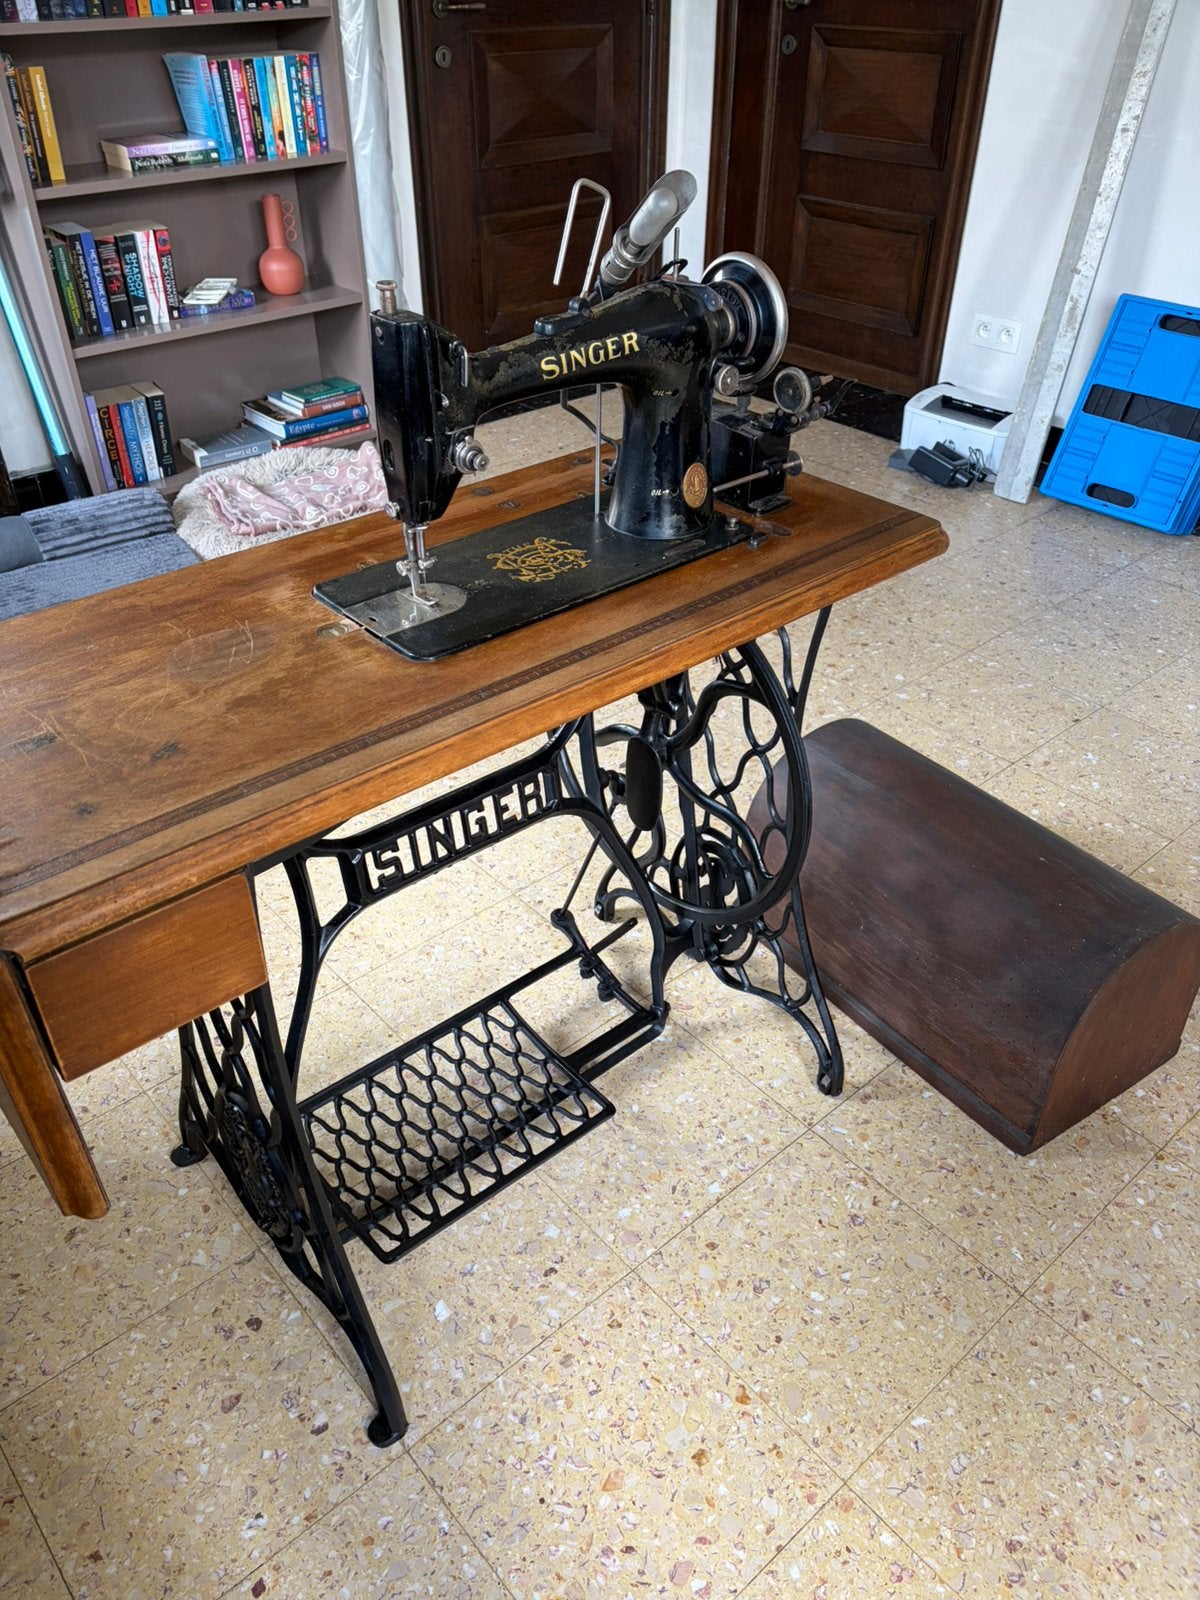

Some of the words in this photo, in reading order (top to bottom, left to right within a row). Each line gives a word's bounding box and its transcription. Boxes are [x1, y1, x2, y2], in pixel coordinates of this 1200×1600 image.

[232, 69, 242, 93] HOOVER
[135, 159, 151, 167] Nora
[74, 241, 82, 254] HET
[89, 249, 98, 264] HET
[124, 254, 130, 263] OF
[77, 255, 88, 280] MEISJE
[128, 252, 145, 297] SHADOW
[93, 265, 105, 296] BLAUWE
[125, 265, 137, 297] NIGHT
[86, 289, 93, 300] DE
[100, 297, 109, 313] UUR
[88, 300, 97, 319] TREIN
[540, 331, 640, 380] SINGER
[99, 407, 119, 461] CIRCE
[122, 405, 133, 429] Stephen
[130, 441, 143, 474] MYTHOS
[136, 402, 148, 428] Stephen
[144, 439, 157, 471] HEROES
[288, 422, 315, 435] Egypte
[374, 777, 547, 883] SINGER
